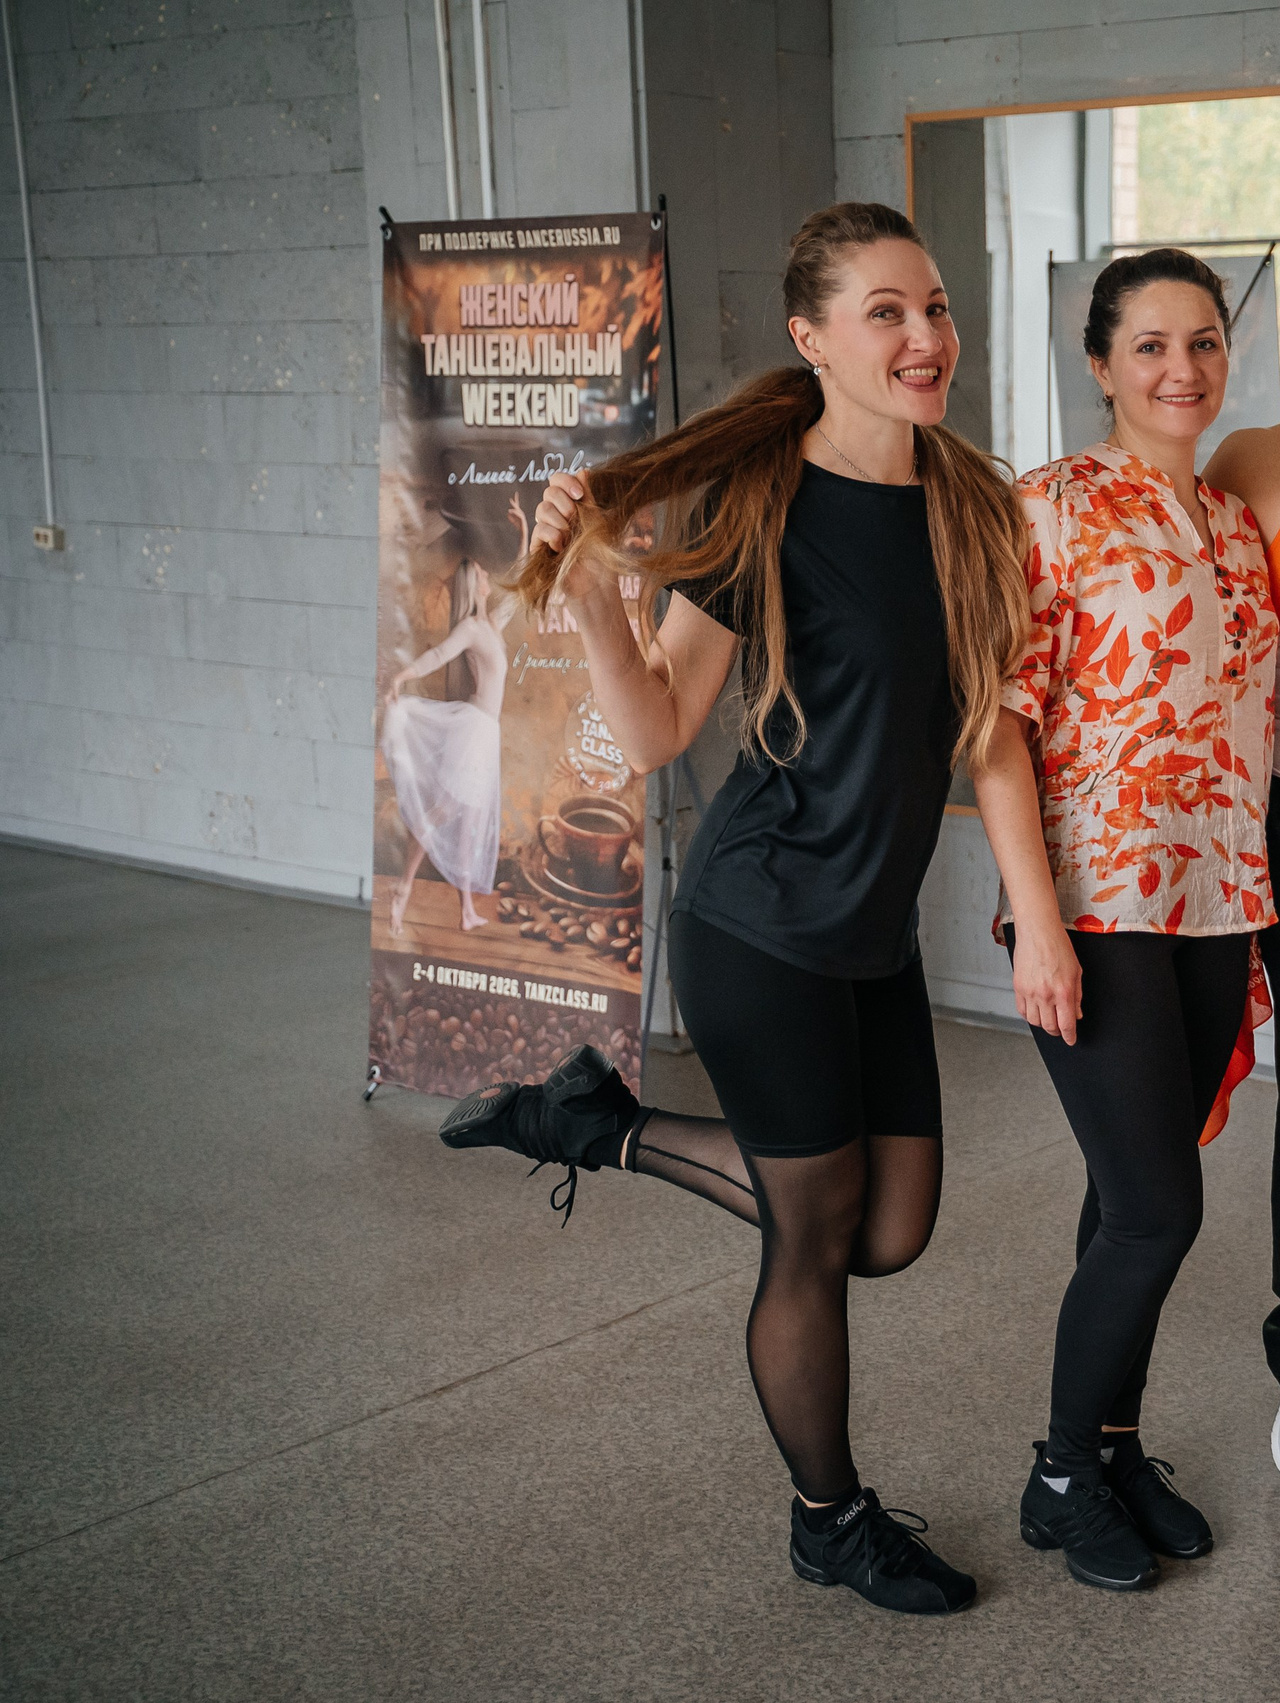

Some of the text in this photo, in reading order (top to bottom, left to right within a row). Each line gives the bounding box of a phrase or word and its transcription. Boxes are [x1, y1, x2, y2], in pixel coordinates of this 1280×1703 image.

[419, 226, 621, 251] ПРИ ПОДДЕРЖКЕ DANCERUSSIA.RU
[459, 273, 579, 327] ЖЕНСКИЙ
[420, 324, 622, 377] ТАНЦЕВАЛЬНЫЙ
[461, 383, 580, 428] WEEKEND
[581, 736, 624, 765] CLASS
[413, 962, 435, 983] 2-4
[437, 966, 488, 992] ОКТЯБРЯ
[524, 981, 609, 1014] TANZCLASS.RU
